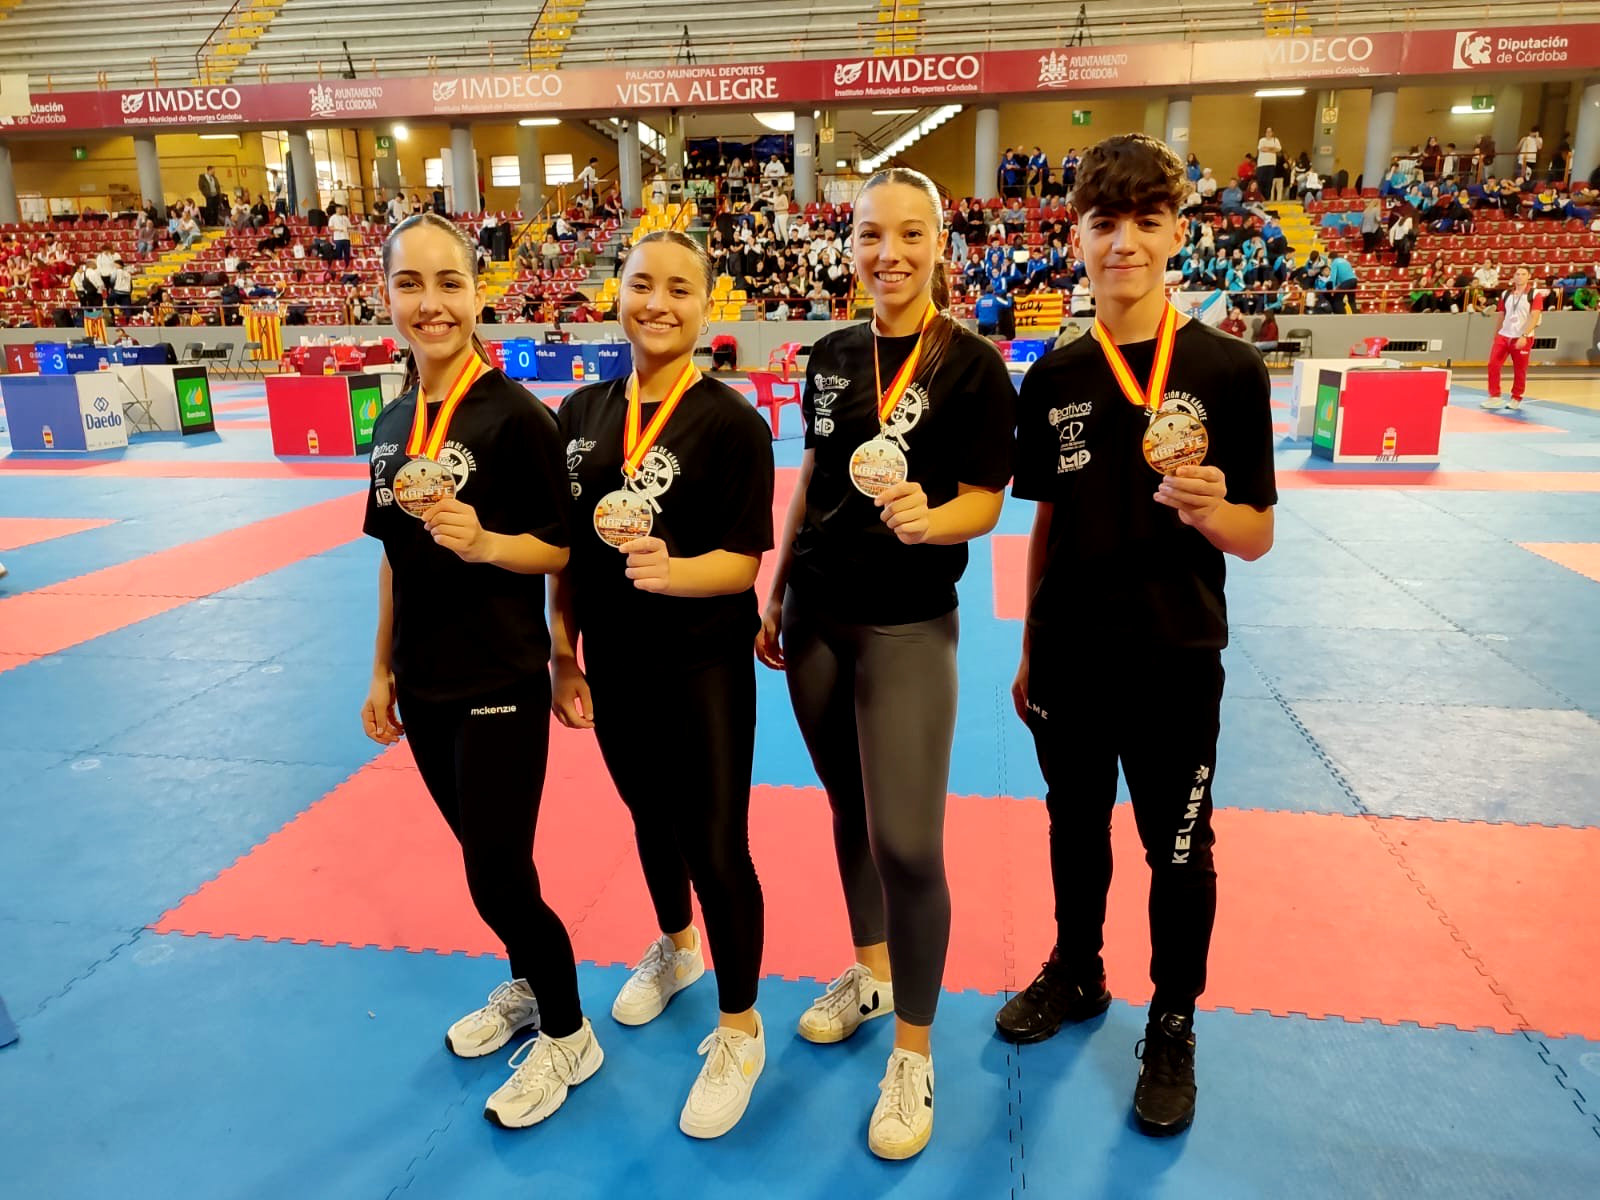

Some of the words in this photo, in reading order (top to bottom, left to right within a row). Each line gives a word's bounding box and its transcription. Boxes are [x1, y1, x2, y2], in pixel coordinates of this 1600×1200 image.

[1258, 36, 1373, 64] MDECO
[1498, 35, 1569, 52] Diputación
[1069, 54, 1128, 67] AYUNTAMIENTO
[1496, 52, 1513, 64] de
[1516, 50, 1568, 63] Córdoba
[625, 70, 665, 80] PALACIO
[667, 67, 717, 79] MUNICIPAL
[719, 65, 765, 77] DEPORTES
[867, 55, 980, 83] IMDECO
[1069, 69, 1080, 80] DE
[1335, 65, 1370, 75] Córdoba
[334, 86, 383, 99] AYUNTAMIENTO
[462, 73, 562, 99] IMDECO
[616, 82, 680, 105] VISTA
[688, 77, 779, 102] ALEGRE
[834, 88, 865, 97] Instituto
[865, 86, 900, 96] Municipal
[901, 86, 911, 94] de
[912, 85, 946, 95] Deportes
[946, 83, 978, 92] Córdoba
[147, 87, 241, 113] IMDECO
[335, 100, 345, 111] DE
[1478, 97, 1487, 109] J
[30, 113, 67, 124] Córdoba
[149, 115, 178, 123] Municipal
[188, 114, 216, 122] Deportes
[14, 355, 23, 371] 1
[52, 354, 64, 370] 3
[112, 351, 119, 362] 1
[518, 351, 530, 368] 0
[588, 361, 596, 373] 3
[1181, 391, 1192, 401] DE
[85, 410, 122, 430] Daedo
[470, 705, 517, 716] mckenzie
[1026, 699, 1049, 720] LME
[1171, 785, 1205, 864] KELME
